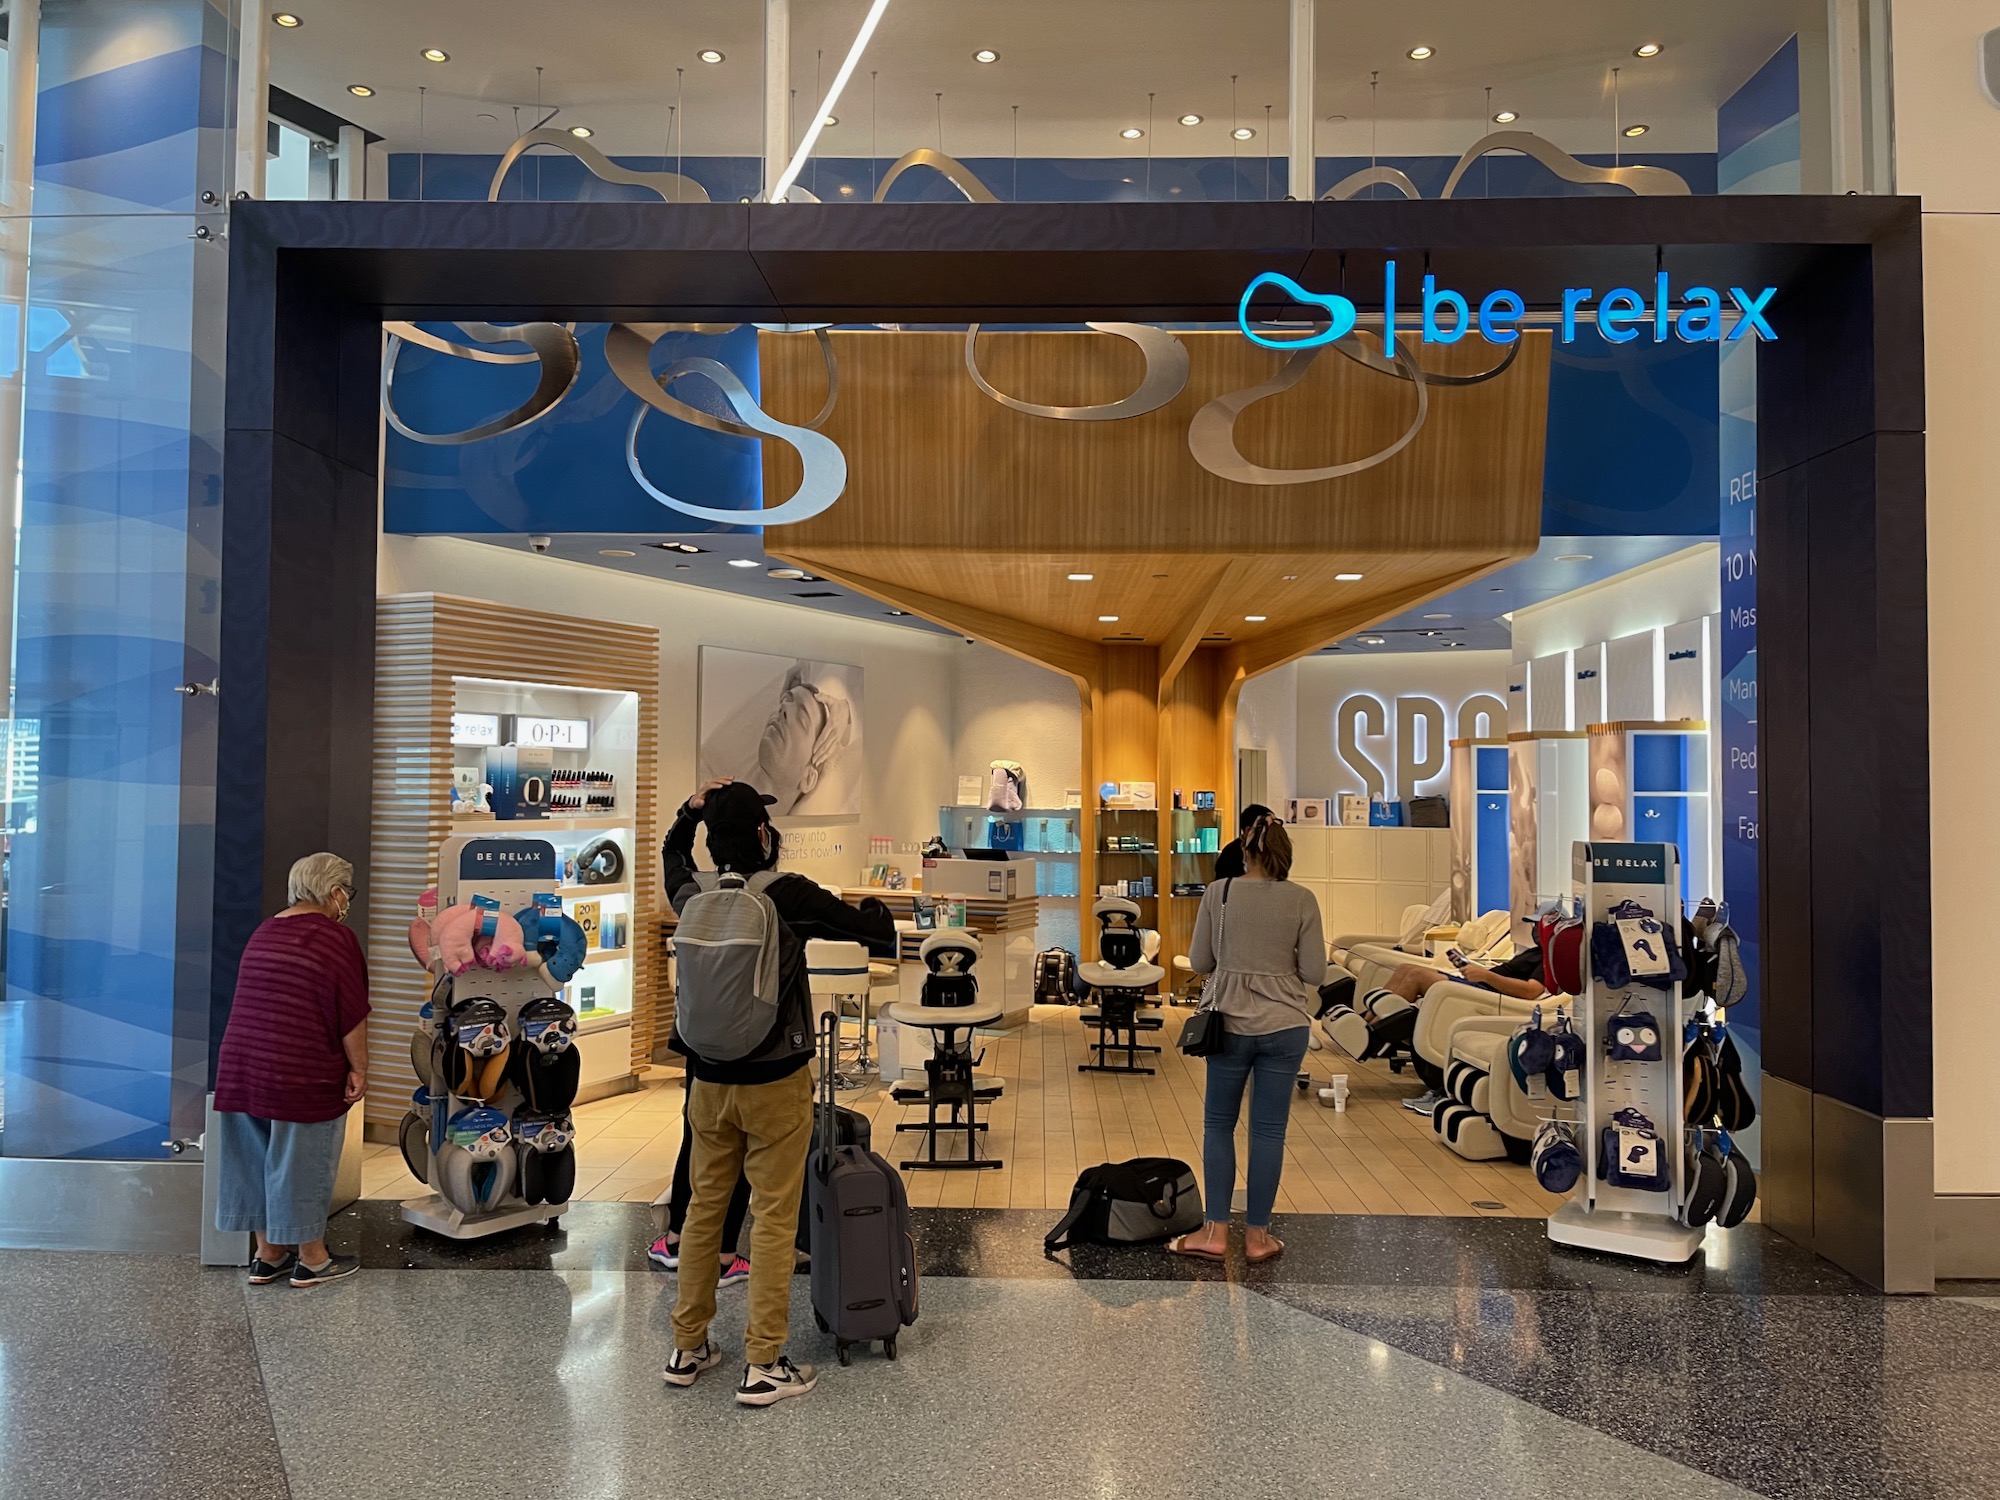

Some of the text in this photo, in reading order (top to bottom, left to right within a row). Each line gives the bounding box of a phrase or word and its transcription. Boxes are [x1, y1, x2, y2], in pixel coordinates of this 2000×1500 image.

[1422, 270, 1780, 345] be relax
[1726, 552, 1744, 582] 10
[808, 829, 827, 843] into
[477, 853, 541, 861] BE RELAX
[1616, 859, 1658, 868] RELAX
